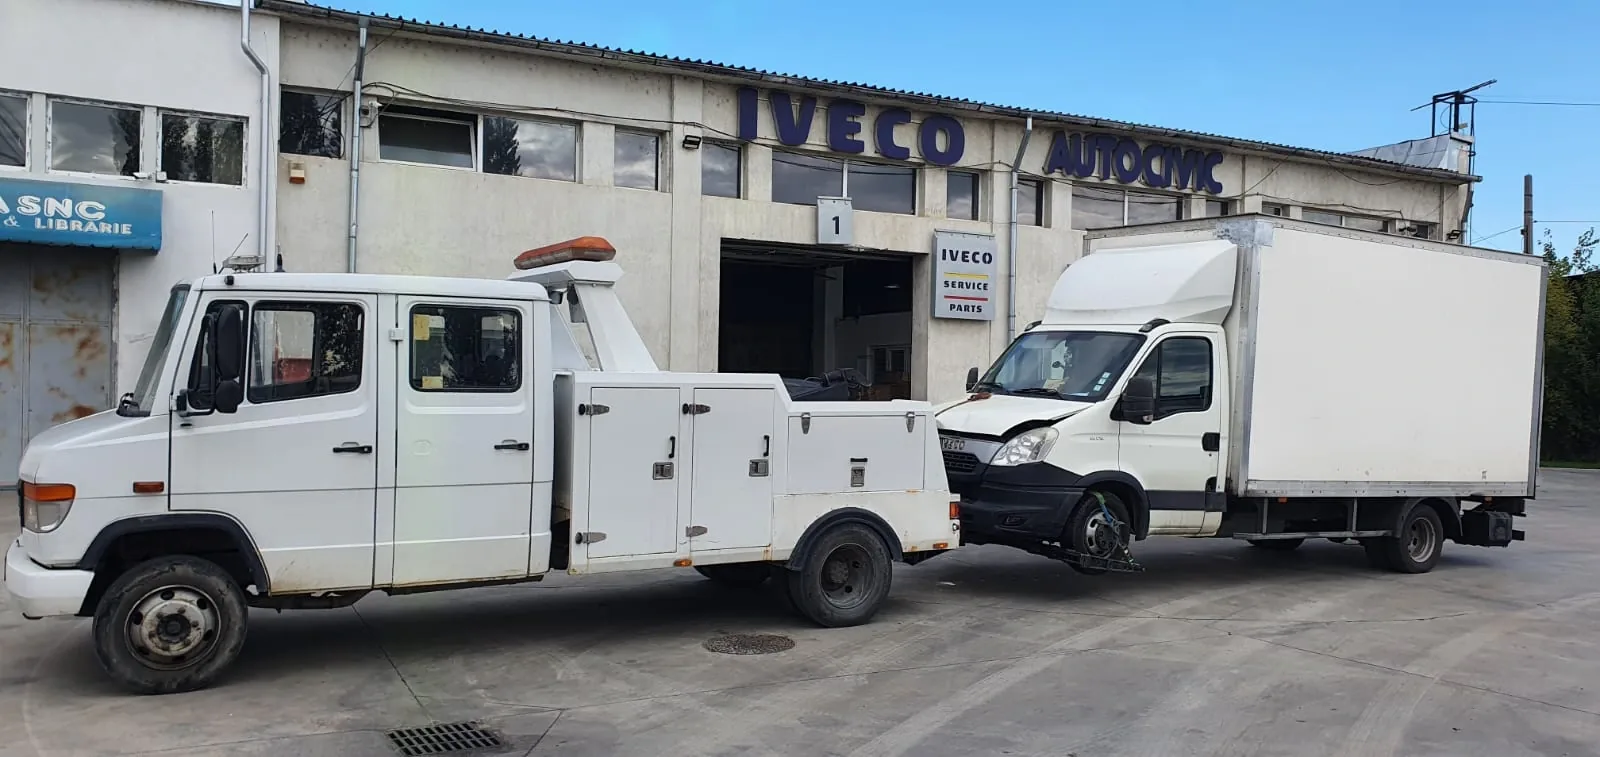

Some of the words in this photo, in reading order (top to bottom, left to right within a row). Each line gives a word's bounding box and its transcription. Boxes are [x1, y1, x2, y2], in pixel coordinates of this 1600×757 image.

[737, 86, 965, 165] IVECO
[1045, 131, 1224, 195] AUTOCIVIC
[17, 195, 106, 221] SNC
[4, 215, 20, 228] &
[34, 217, 133, 235] LIBRARIE
[832, 215, 840, 235] 1
[941, 248, 993, 265] IVECO
[943, 280, 989, 291] SERVICE
[949, 303, 983, 313] PARTS
